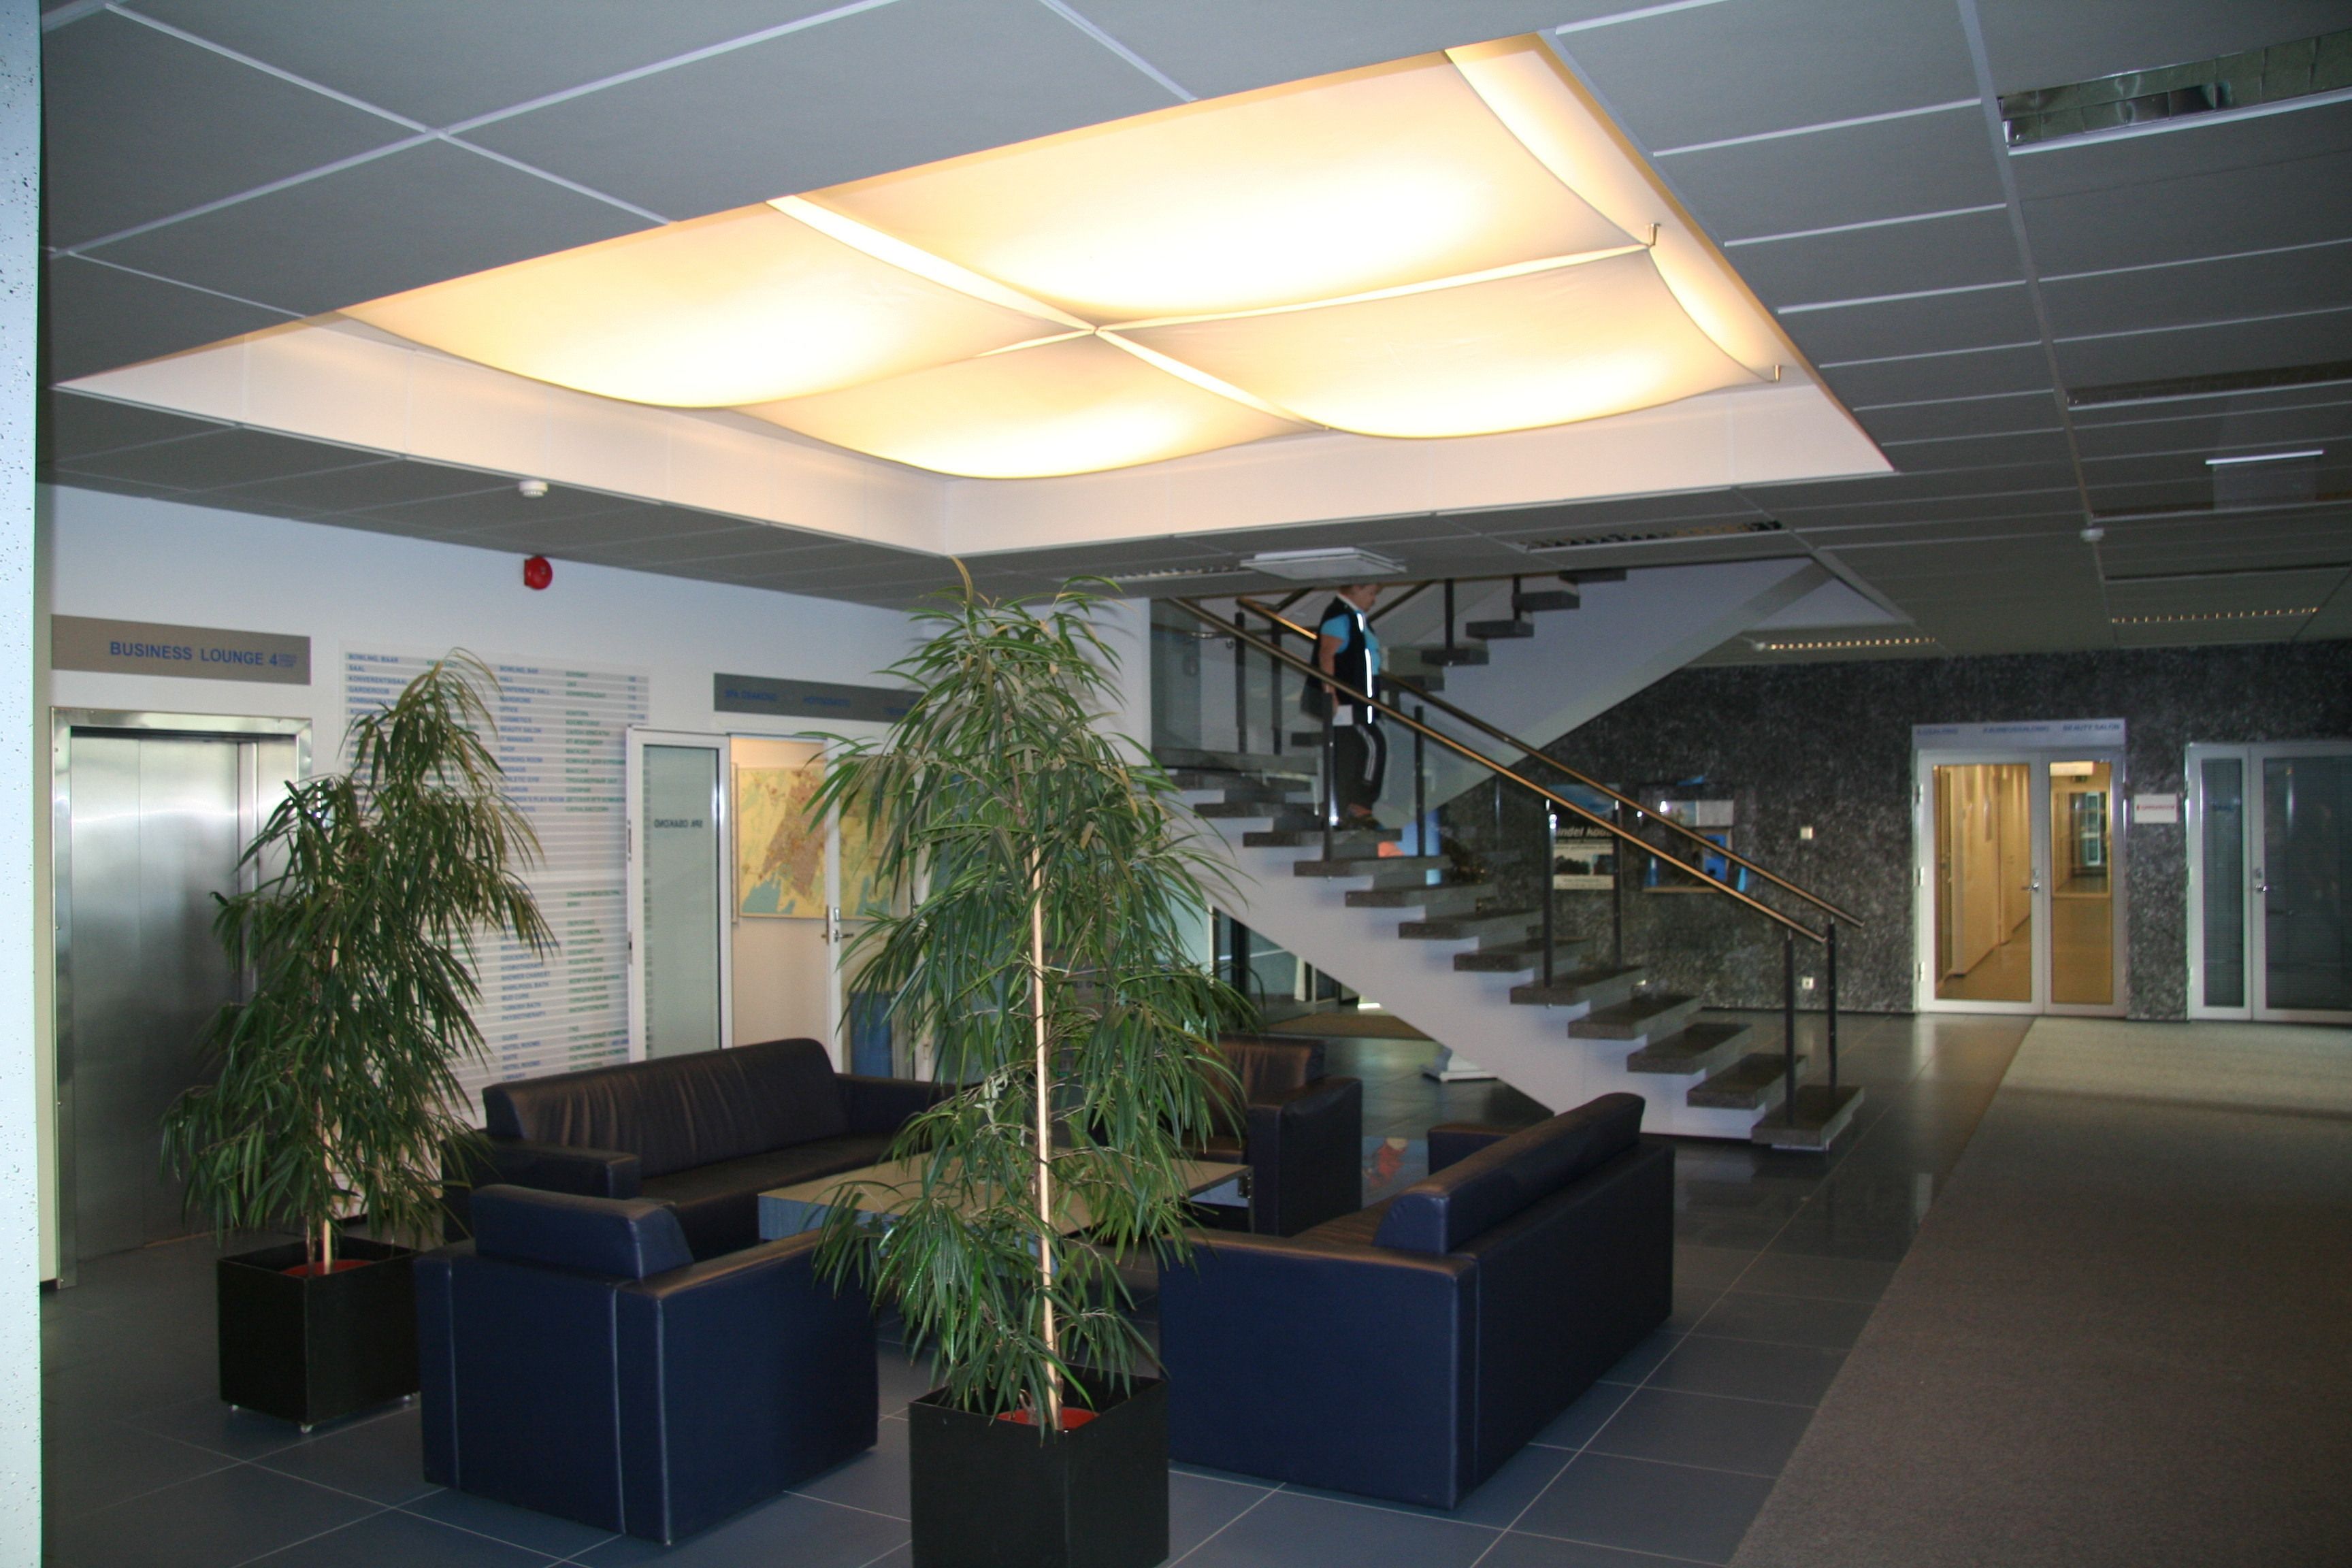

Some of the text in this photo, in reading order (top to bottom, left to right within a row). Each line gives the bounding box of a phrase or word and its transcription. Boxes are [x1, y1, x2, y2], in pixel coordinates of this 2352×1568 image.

[110, 642, 193, 660] BUSINESS
[201, 649, 264, 665] LOUNGE
[269, 653, 278, 666] 4
